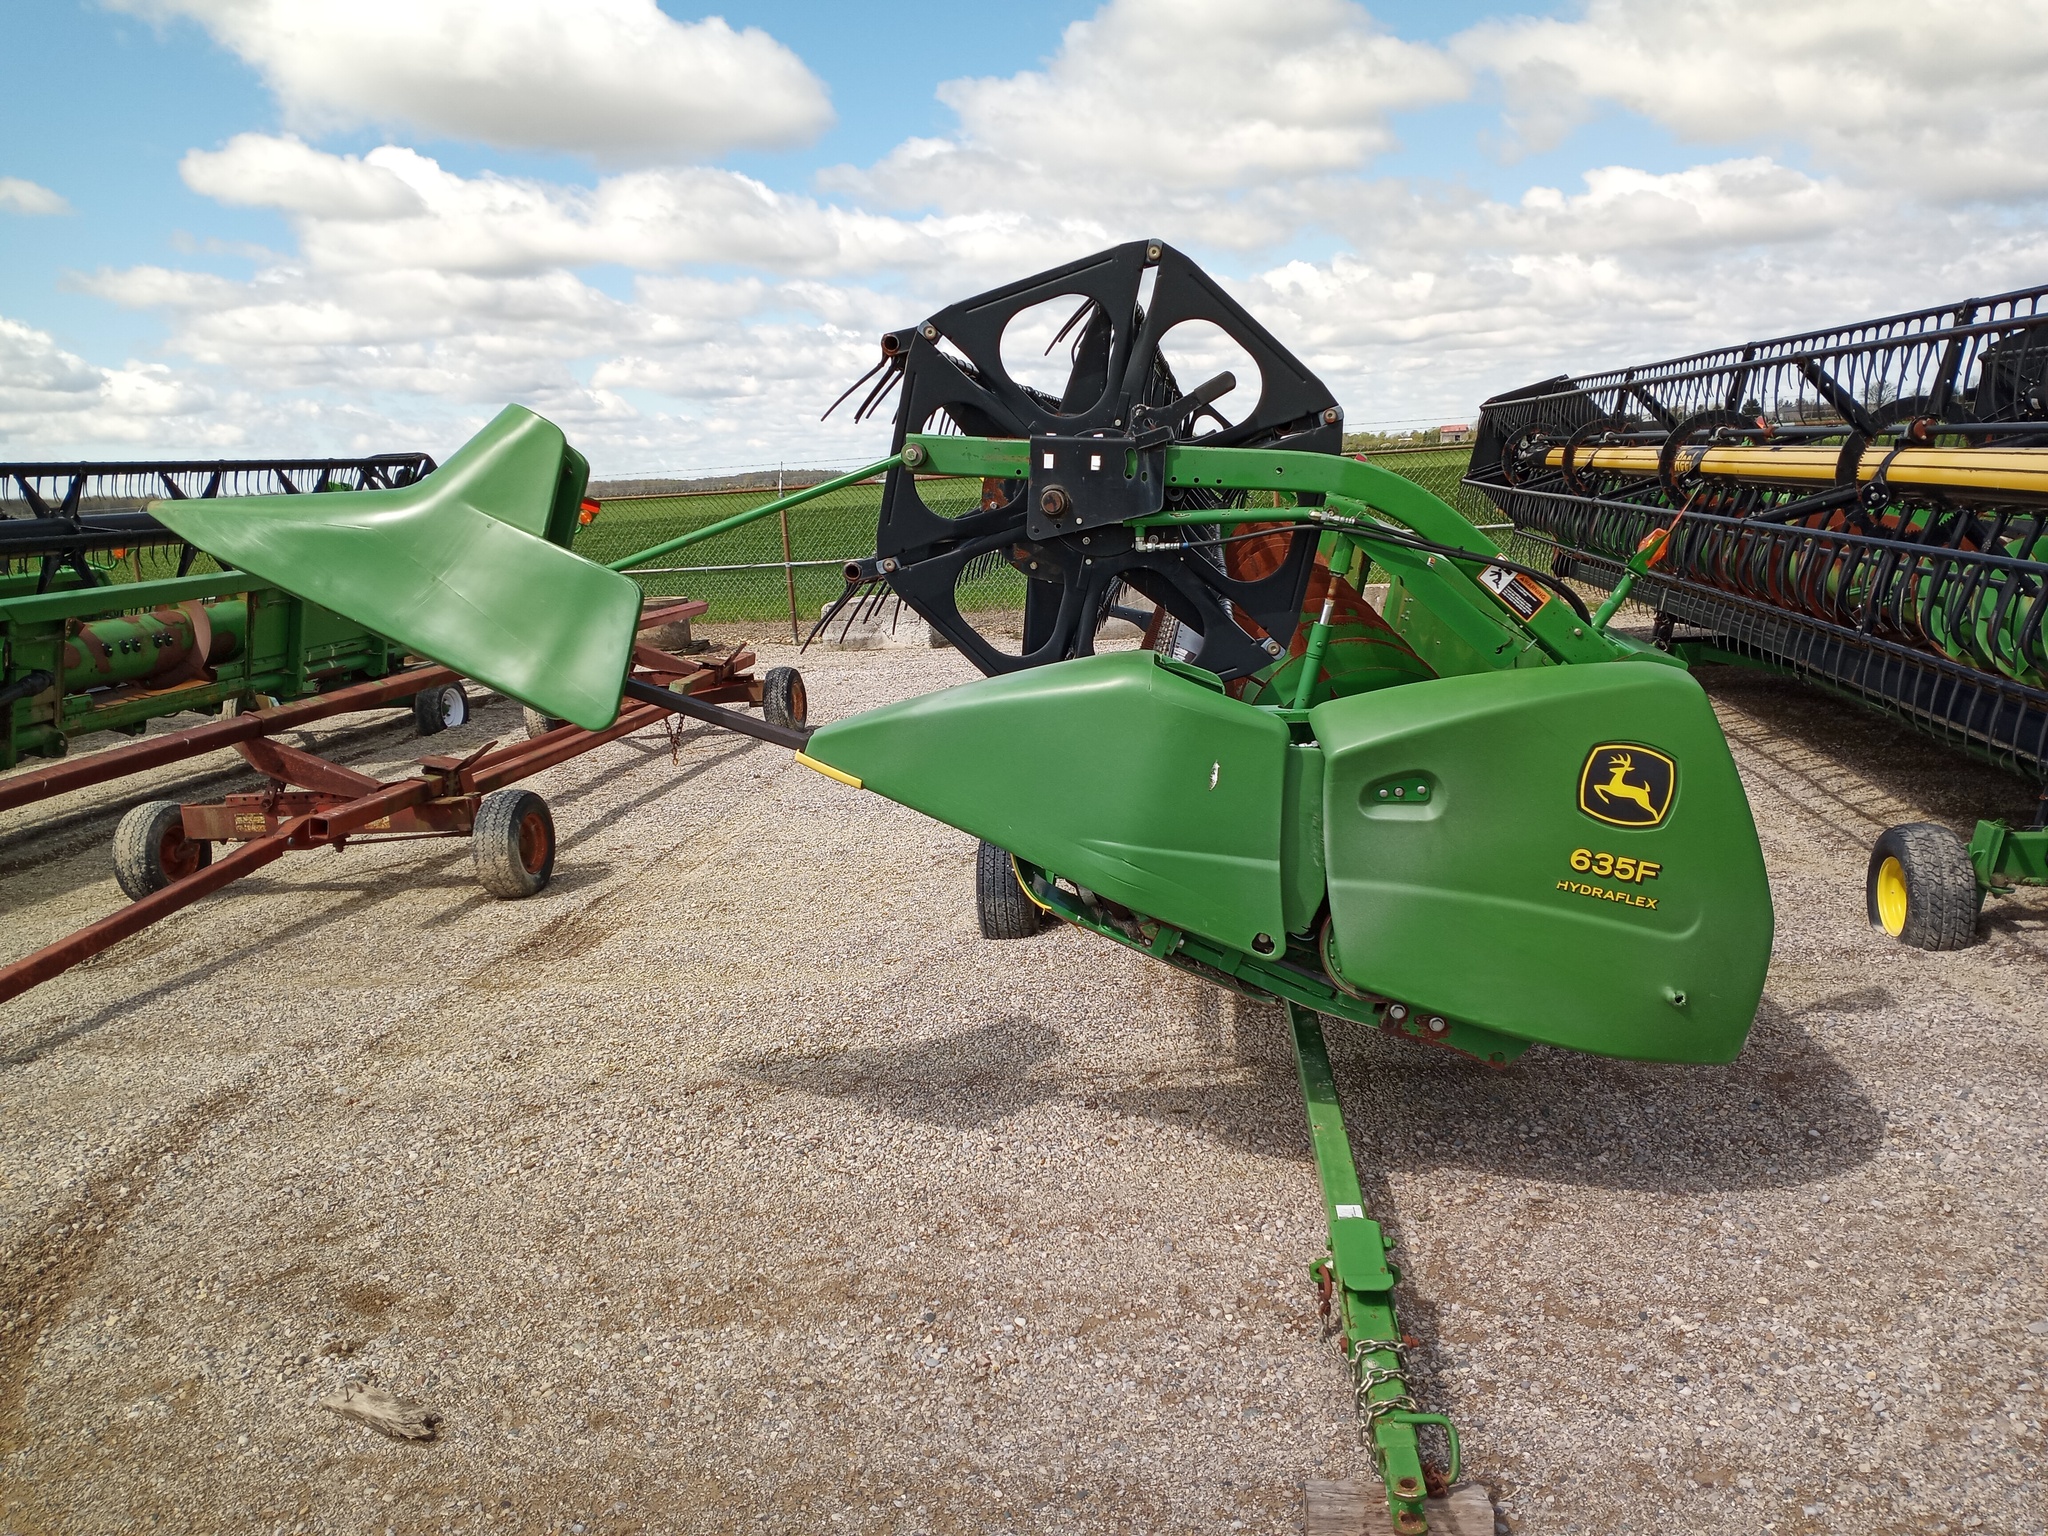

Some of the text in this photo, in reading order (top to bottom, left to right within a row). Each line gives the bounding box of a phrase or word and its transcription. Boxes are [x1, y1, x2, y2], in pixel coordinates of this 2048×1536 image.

[1523, 578, 1547, 601] WARNING
[1569, 847, 1662, 884] 635F
[1556, 880, 1659, 910] HYDRAFLEX
